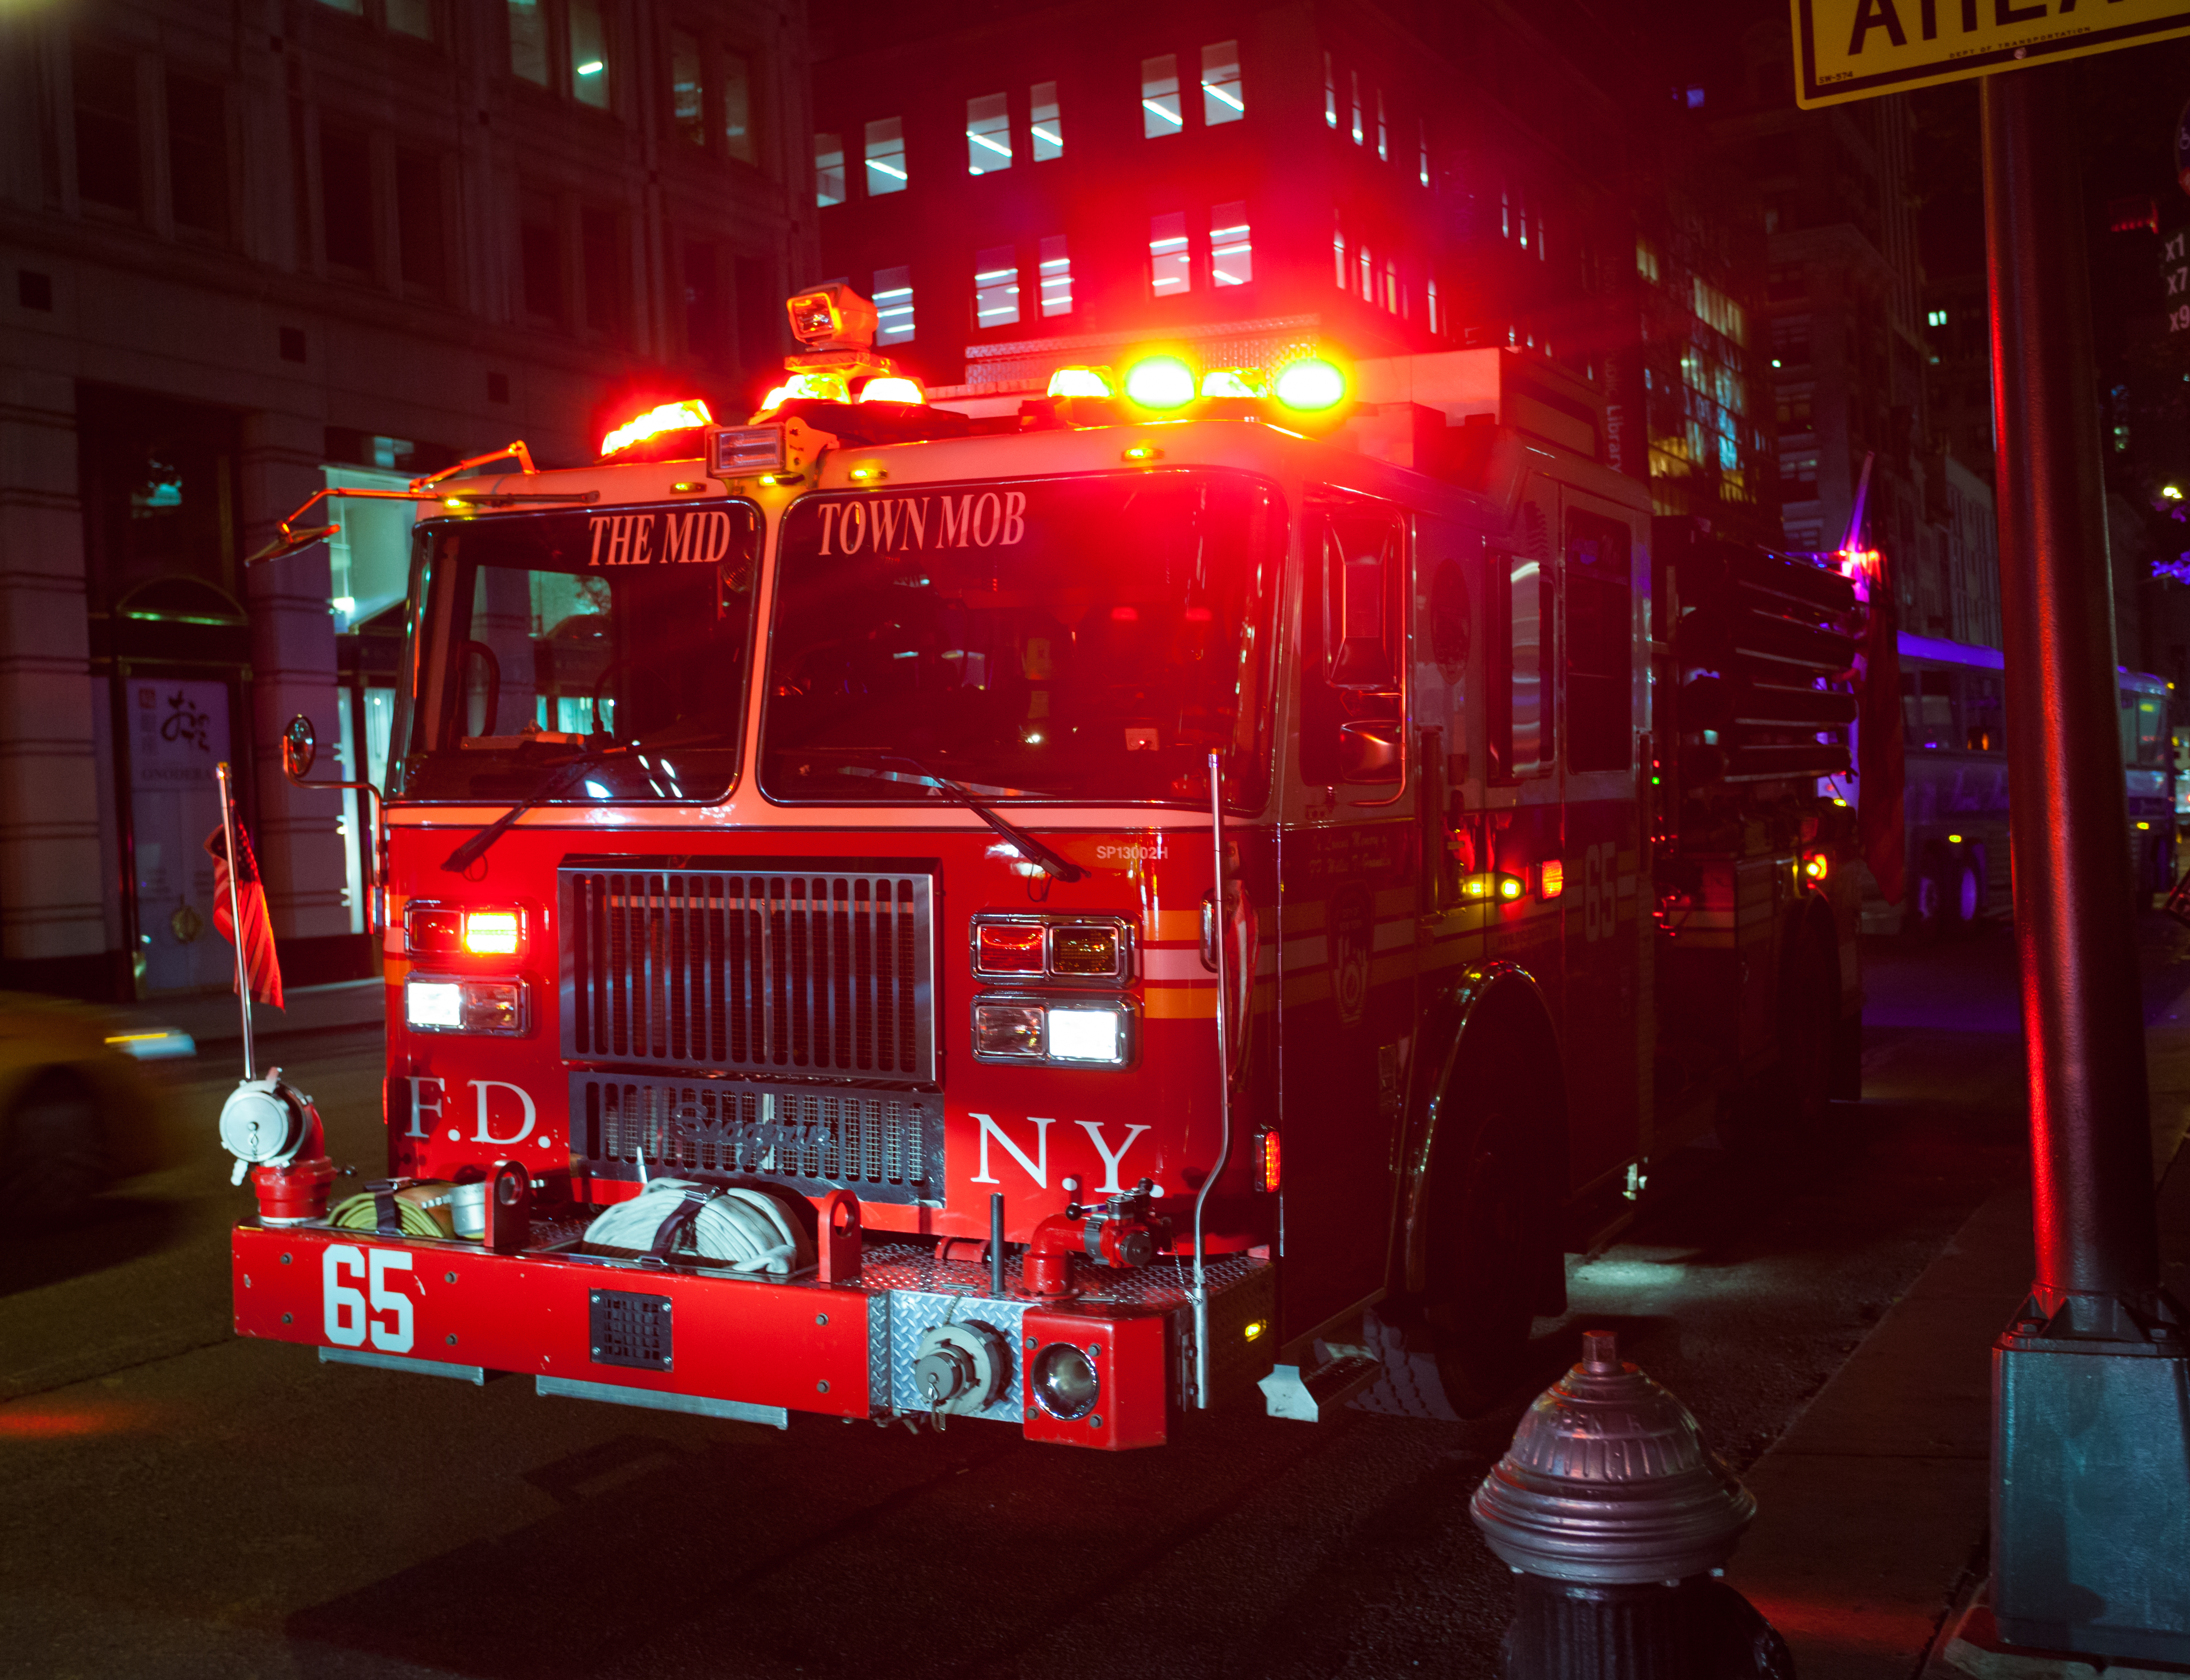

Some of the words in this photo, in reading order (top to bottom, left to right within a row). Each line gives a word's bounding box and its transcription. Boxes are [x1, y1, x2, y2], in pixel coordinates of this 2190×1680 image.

[1949, 49, 1975, 59] DEPT
[1999, 27, 2090, 49] TRANSPORTATION
[1606, 404, 1624, 473] Library
[587, 513, 655, 567] THE
[659, 511, 731, 564] MID
[818, 497, 930, 556] TOWN
[935, 491, 1026, 548] MOB
[1096, 845, 1168, 860] SP13002H
[1585, 841, 1615, 943] 65
[404, 1075, 552, 1149] F.D.
[967, 1112, 1165, 1198] N.Y.
[322, 1244, 414, 1354] 65
